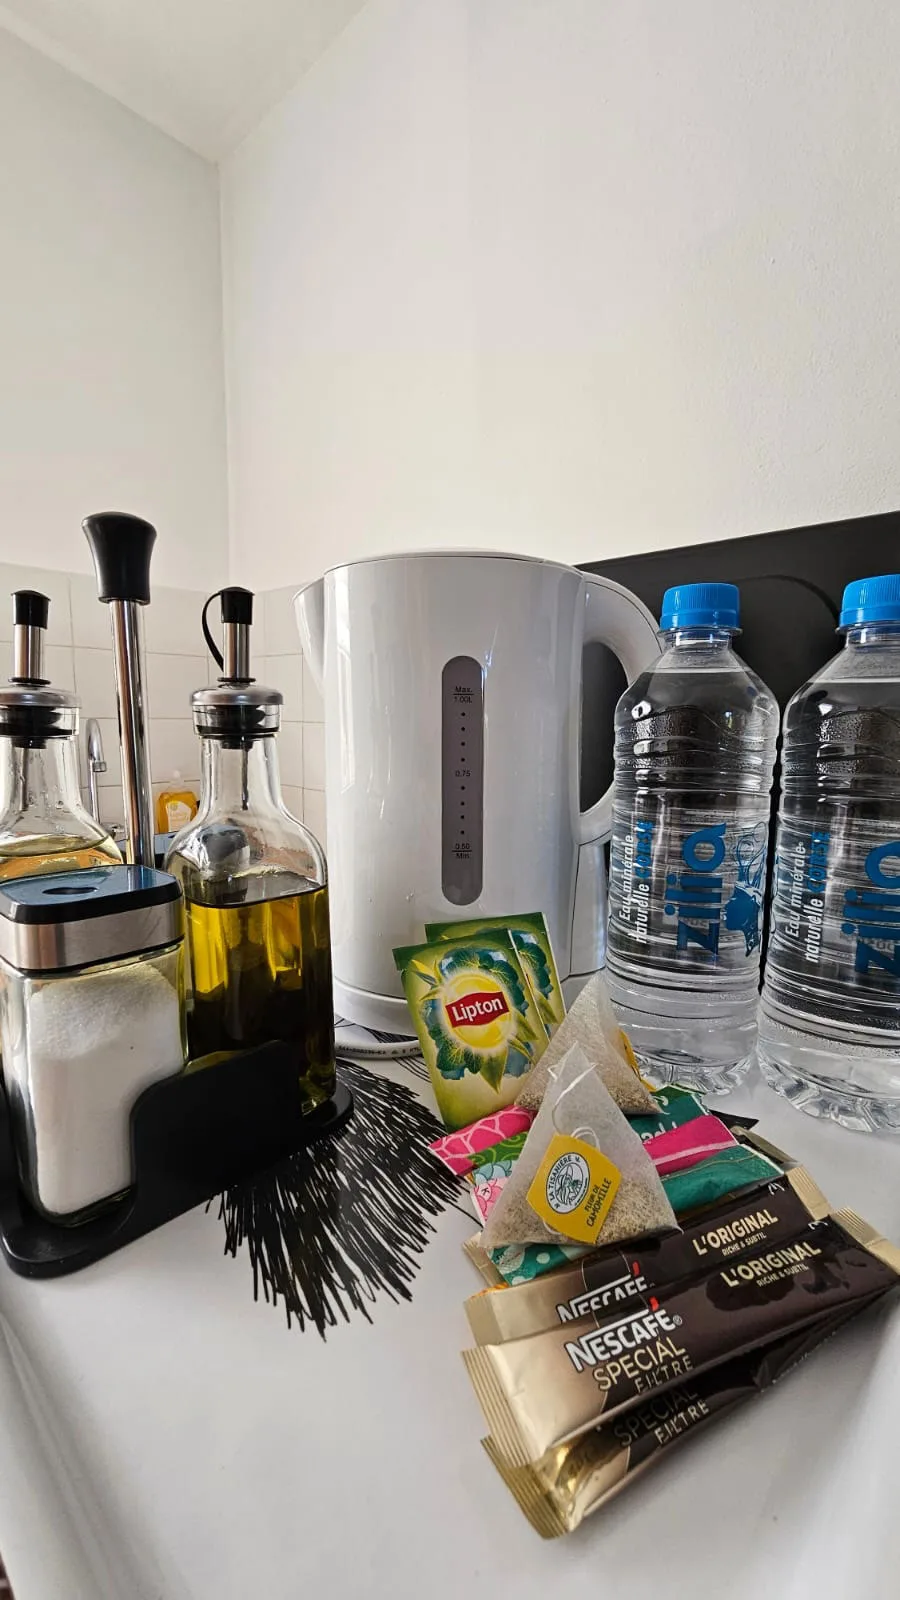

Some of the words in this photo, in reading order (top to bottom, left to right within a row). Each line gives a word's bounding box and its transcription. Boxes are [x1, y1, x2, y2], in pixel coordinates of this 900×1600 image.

[455, 770, 471, 778] 0.75
[621, 835, 634, 893] minérale
[790, 842, 806, 908] minérale
[619, 895, 631, 921] Eau
[664, 822, 726, 955] zilia
[631, 883, 650, 944] naturelle
[785, 911, 801, 938] Eau
[803, 898, 824, 963] naturelle
[451, 997, 504, 1022] Lipton
[692, 1209, 779, 1256] L'ORIGINAL
[721, 1243, 740, 1256] RICHE
[745, 1231, 767, 1246] SUBTIL
[720, 1241, 822, 1288] L'ORIGINAL
[756, 1273, 780, 1287] RICHE
[784, 1263, 810, 1277] SUBTIL
[593, 1336, 686, 1391] SPECIAL
[634, 1355, 694, 1392] FILTRE
[654, 1399, 710, 1445] FILTRE
